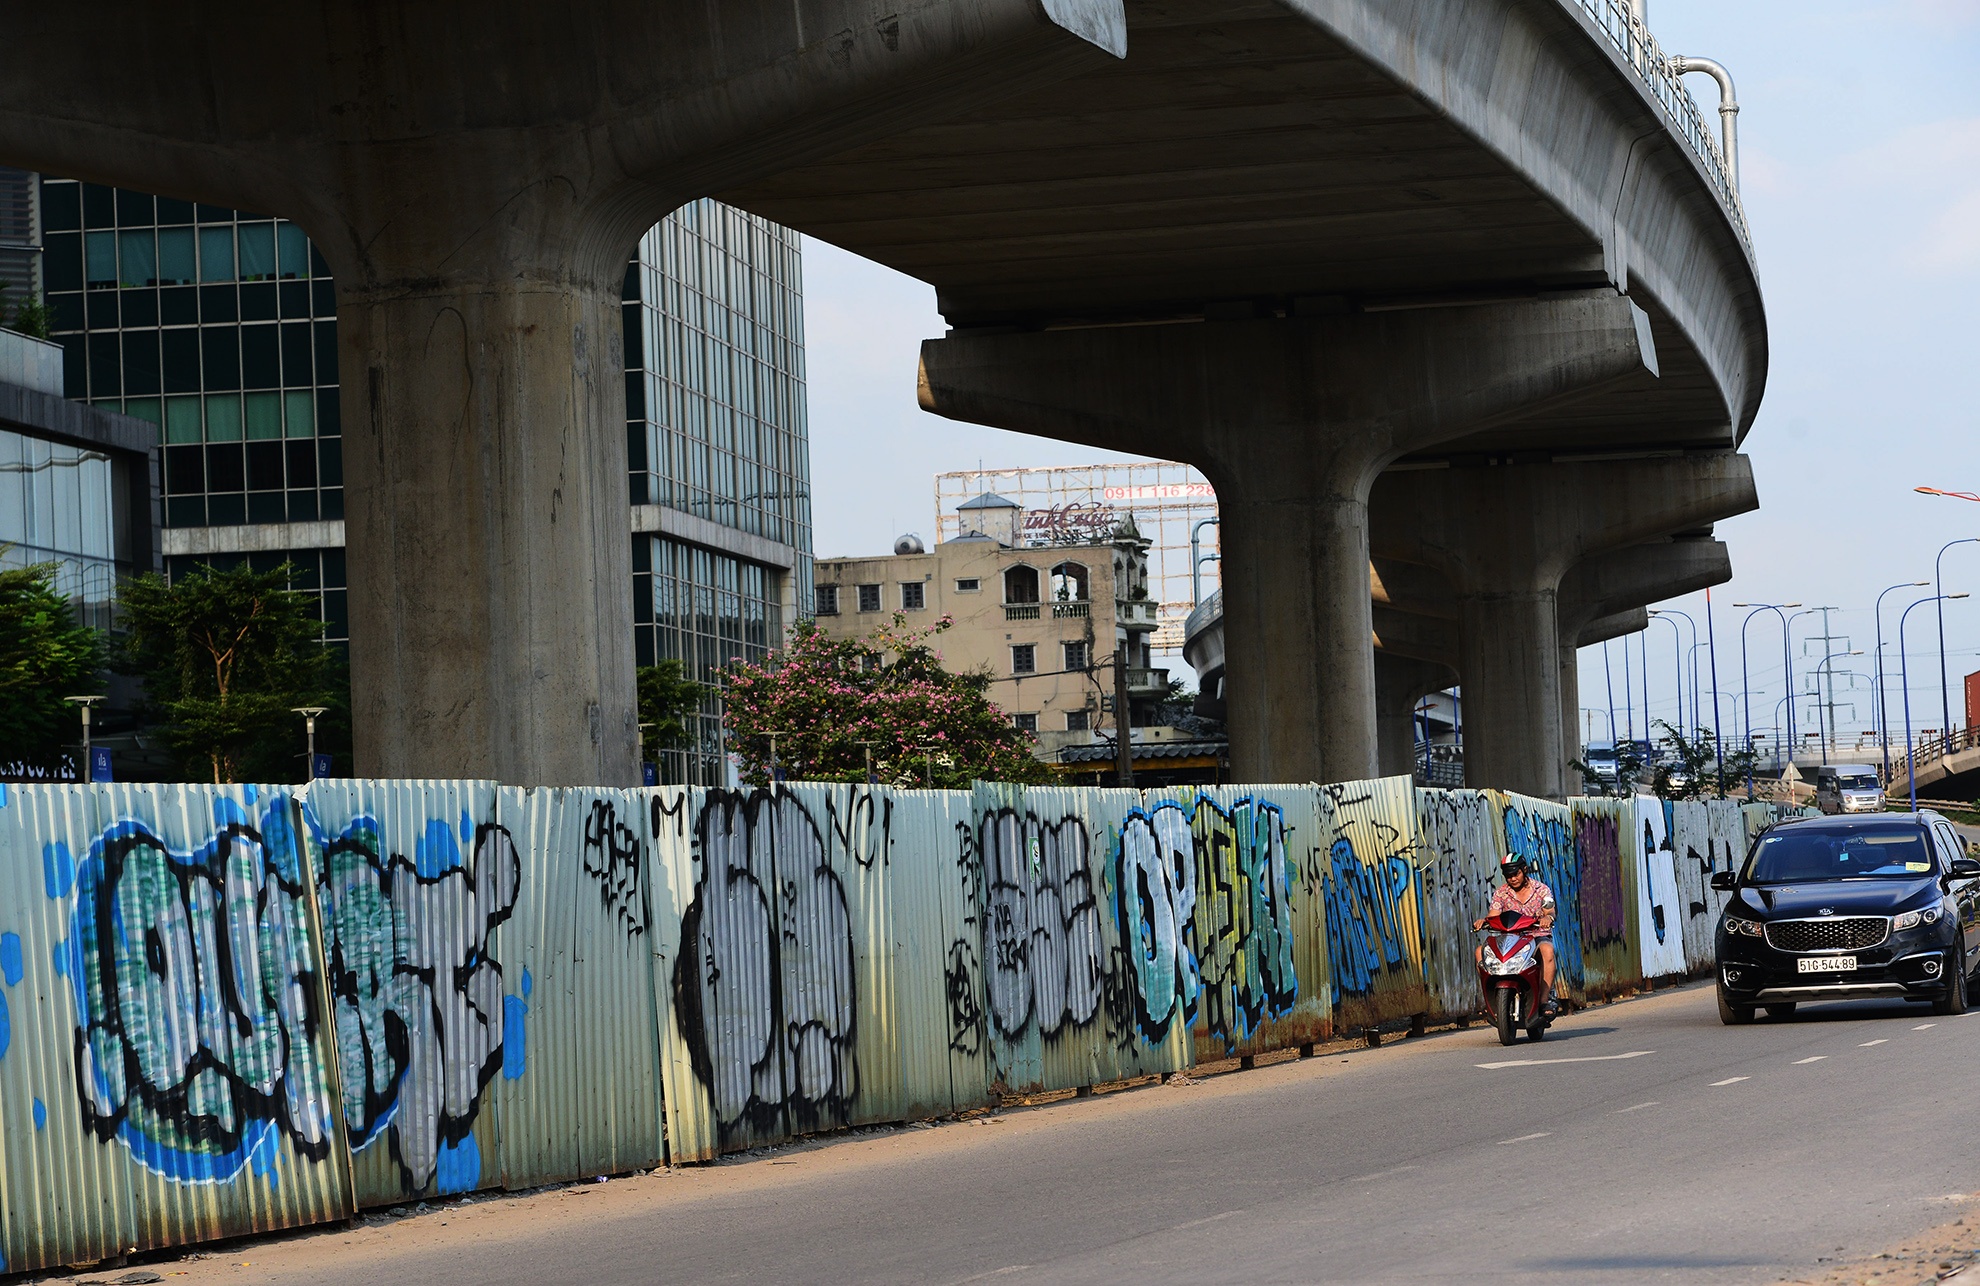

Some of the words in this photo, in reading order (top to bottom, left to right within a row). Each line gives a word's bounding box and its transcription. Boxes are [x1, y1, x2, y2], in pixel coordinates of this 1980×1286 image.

[1105, 486, 1143, 500] 0911
[1151, 485, 1180, 498] 116
[1185, 484, 1215, 497] 228
